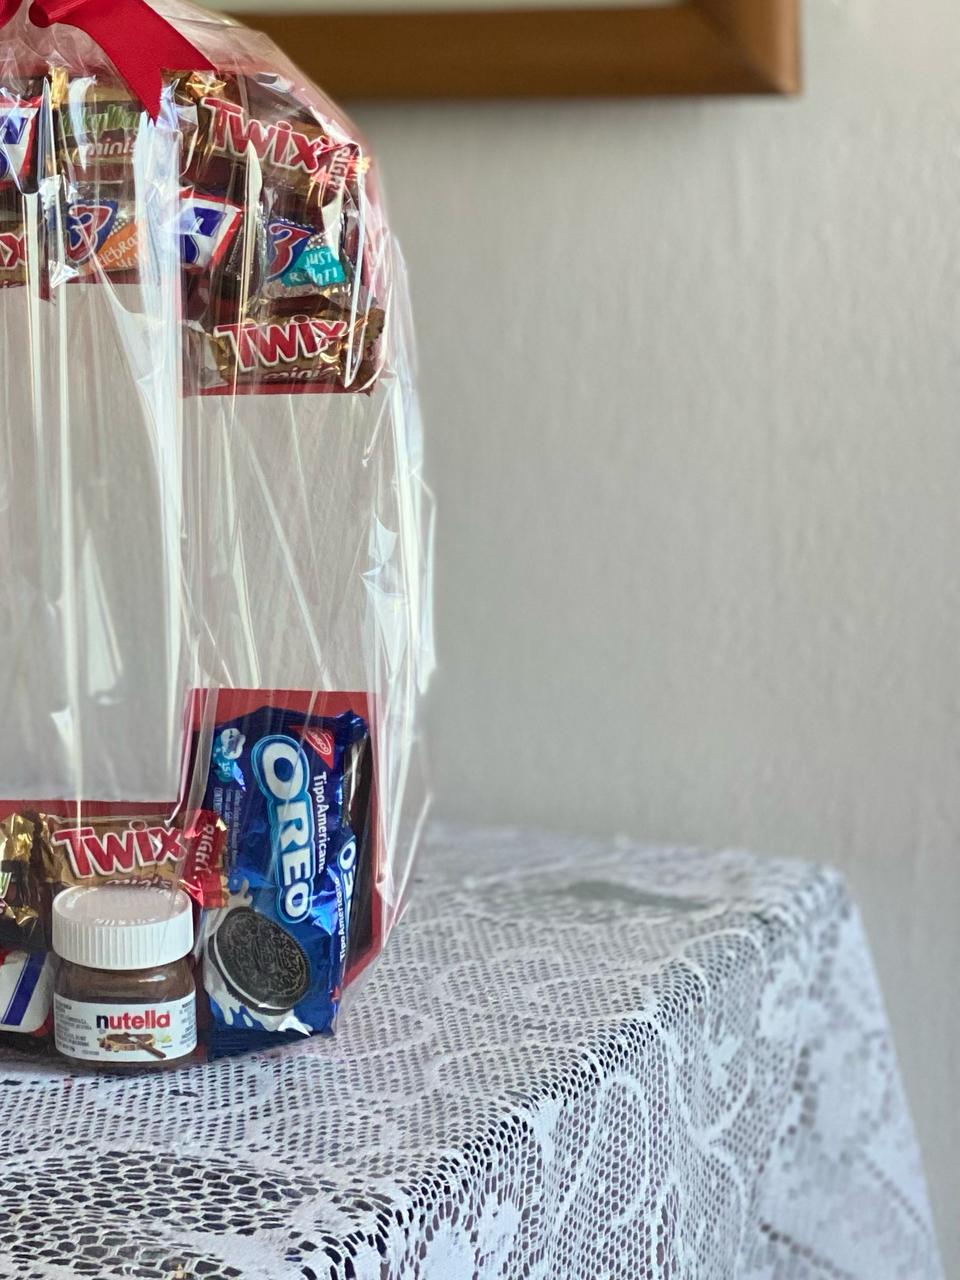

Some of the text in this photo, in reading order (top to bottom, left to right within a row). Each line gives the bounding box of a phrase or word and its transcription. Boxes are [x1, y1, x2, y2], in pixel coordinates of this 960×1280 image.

[65, 204, 113, 263] 3
[267, 222, 312, 281] 3
[313, 771, 327, 805] Tipo
[260, 740, 312, 920] OREO
[96, 1010, 171, 1030] nutella
